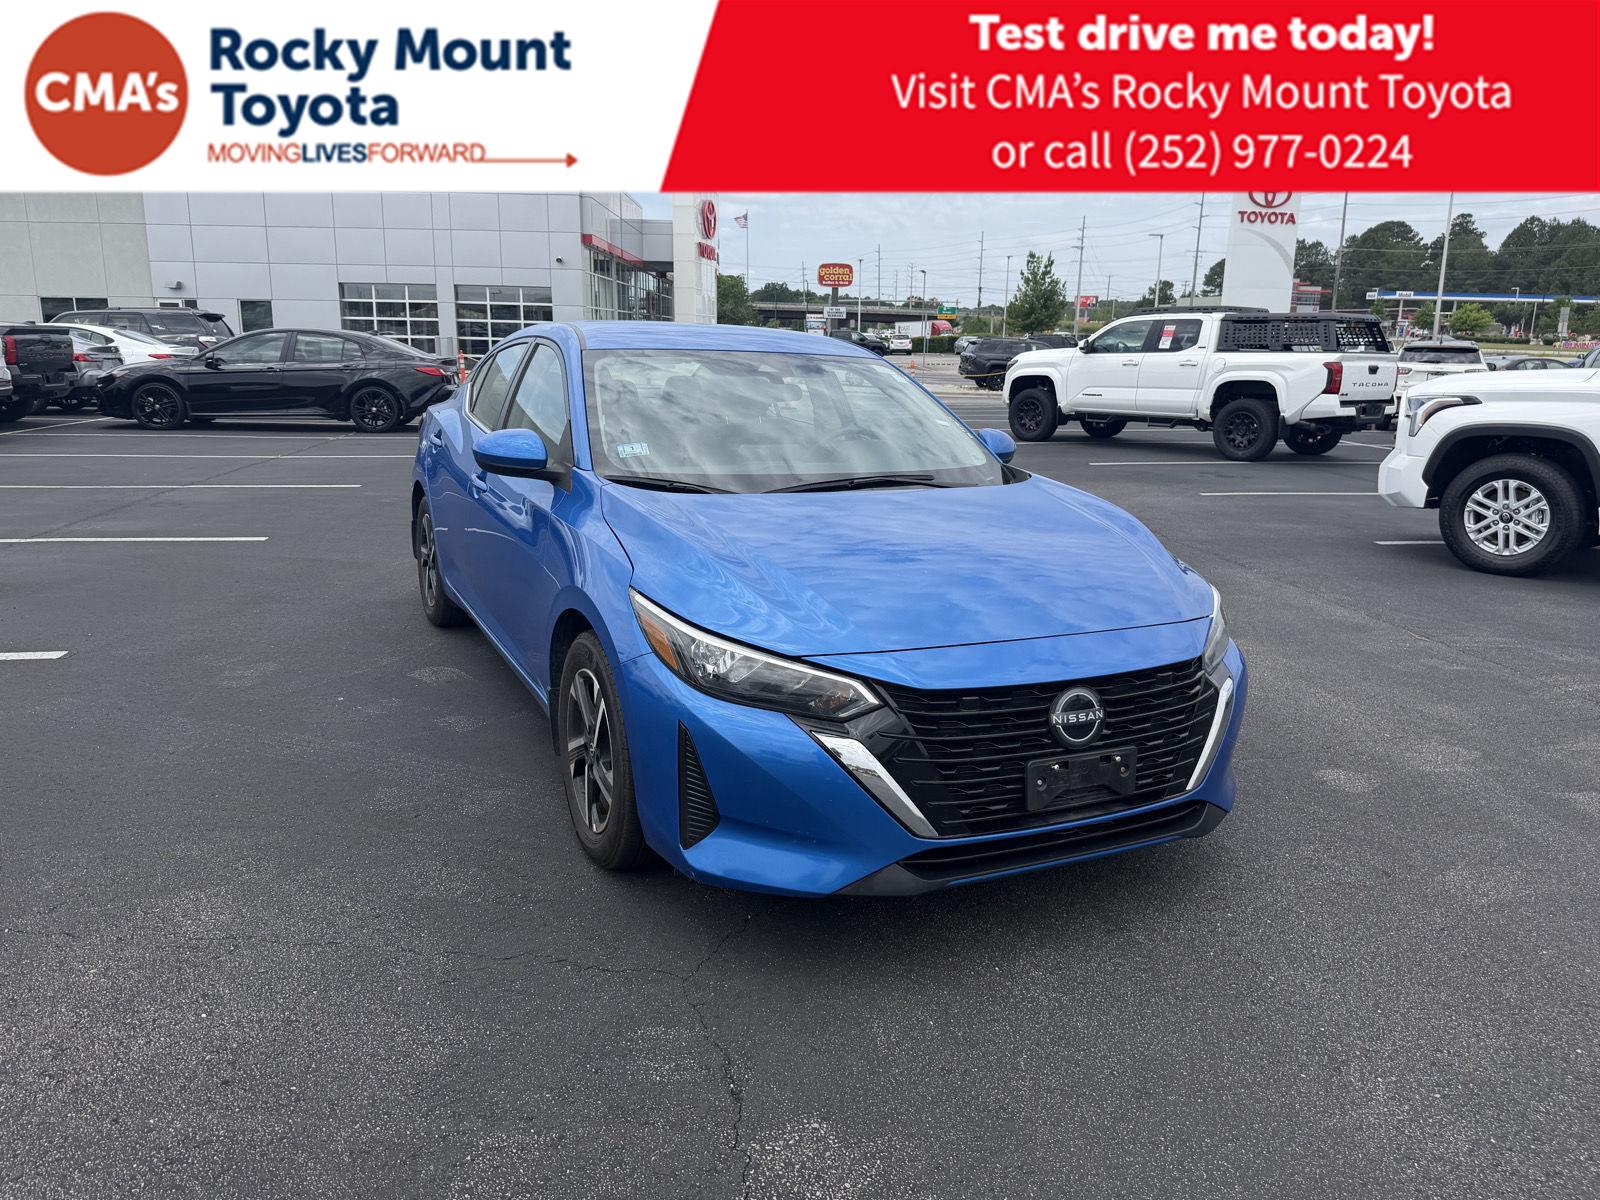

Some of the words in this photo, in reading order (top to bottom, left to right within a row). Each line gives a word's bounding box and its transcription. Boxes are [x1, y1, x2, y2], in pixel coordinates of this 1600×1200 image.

[1238, 211, 1296, 224] TOYOTA
[819, 267, 849, 275] golden
[824, 273, 853, 281] corral
[1052, 709, 1103, 724] NISSAN
